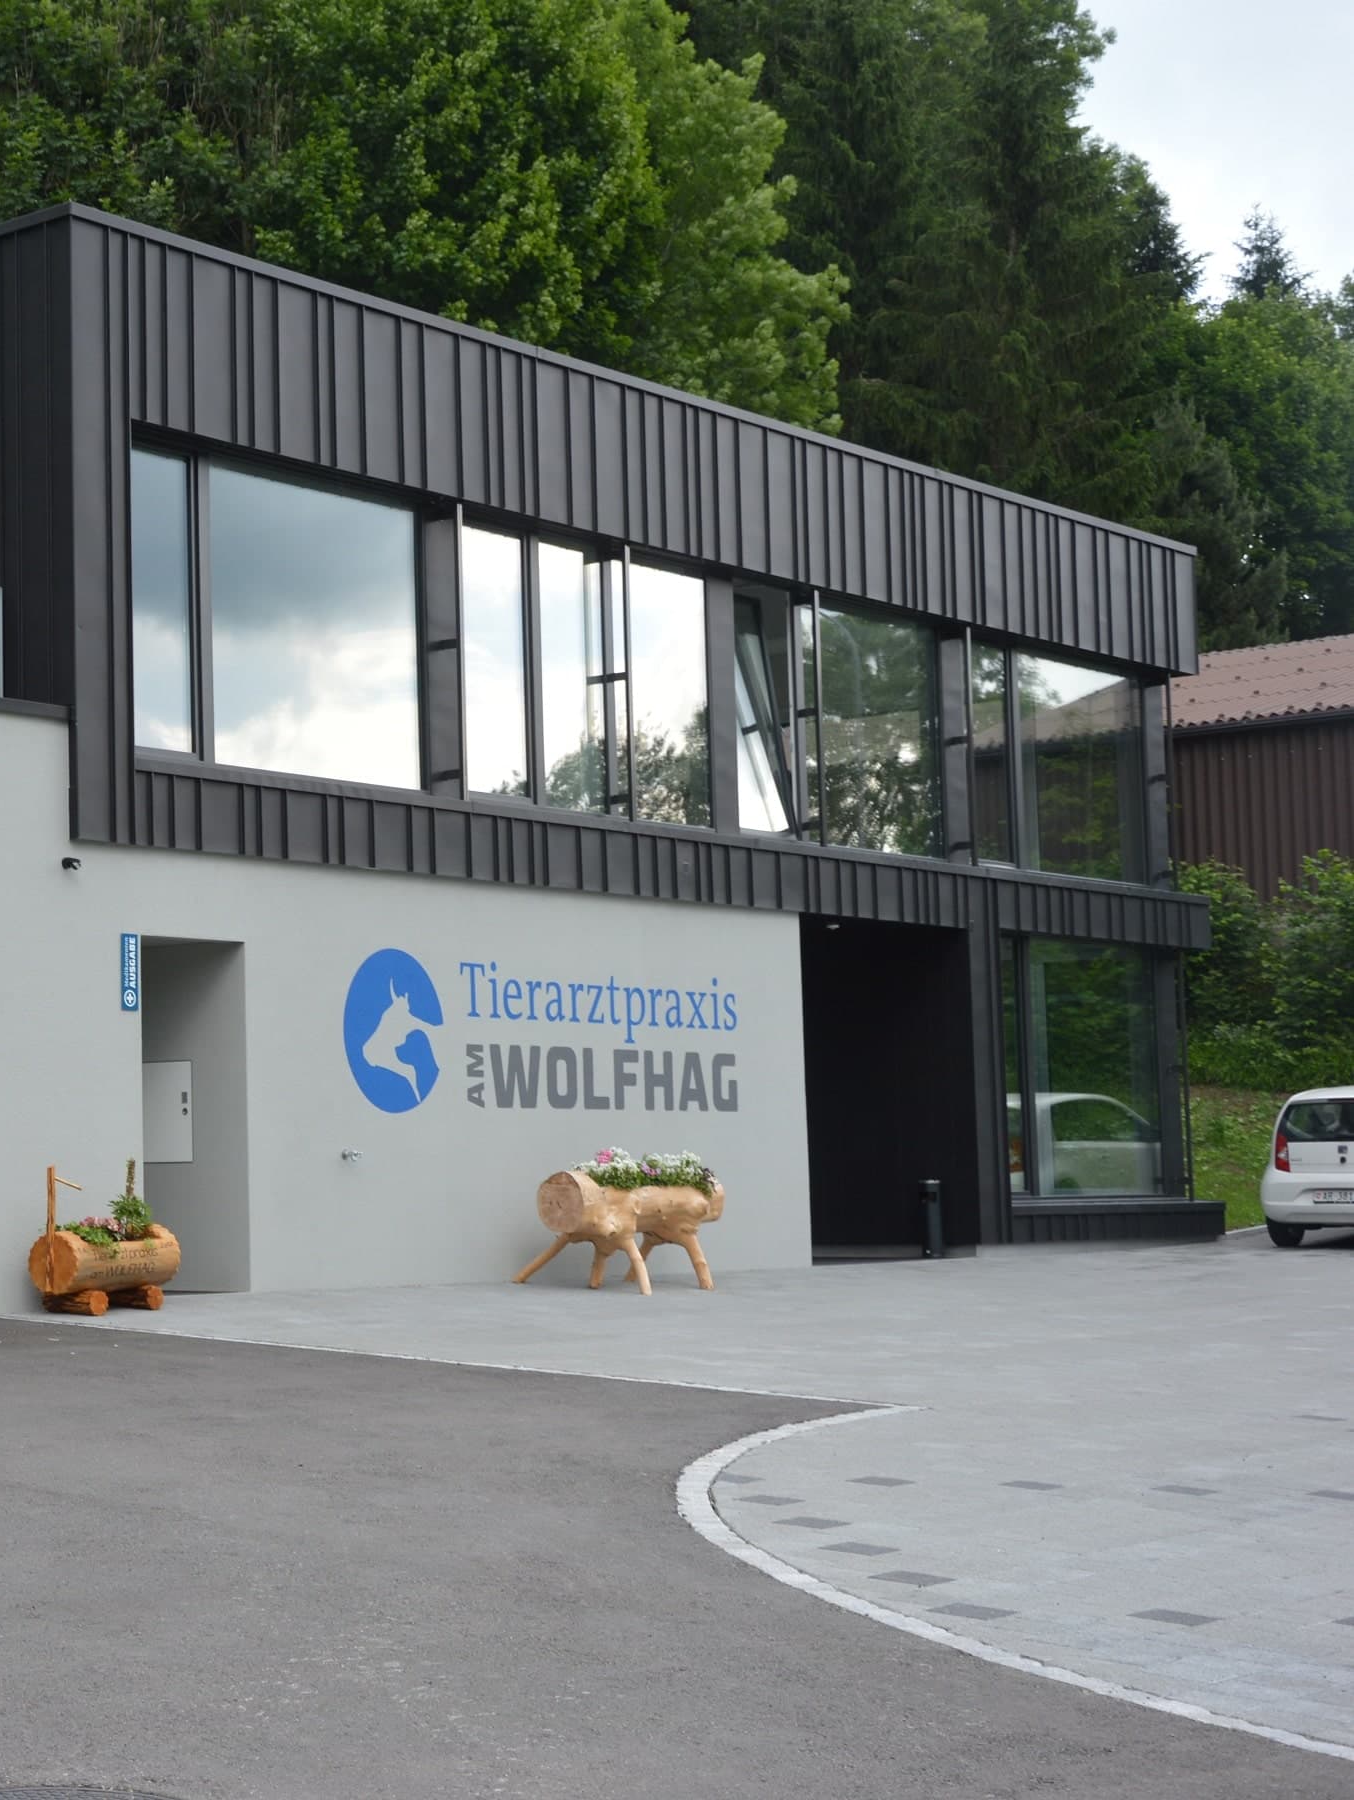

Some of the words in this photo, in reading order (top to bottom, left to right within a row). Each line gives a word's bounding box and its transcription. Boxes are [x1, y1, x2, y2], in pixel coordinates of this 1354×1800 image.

[459, 961, 738, 1044] Tierarztpraxis
[465, 1043, 485, 1108] AM
[489, 1043, 739, 1112] WOLFHAG
